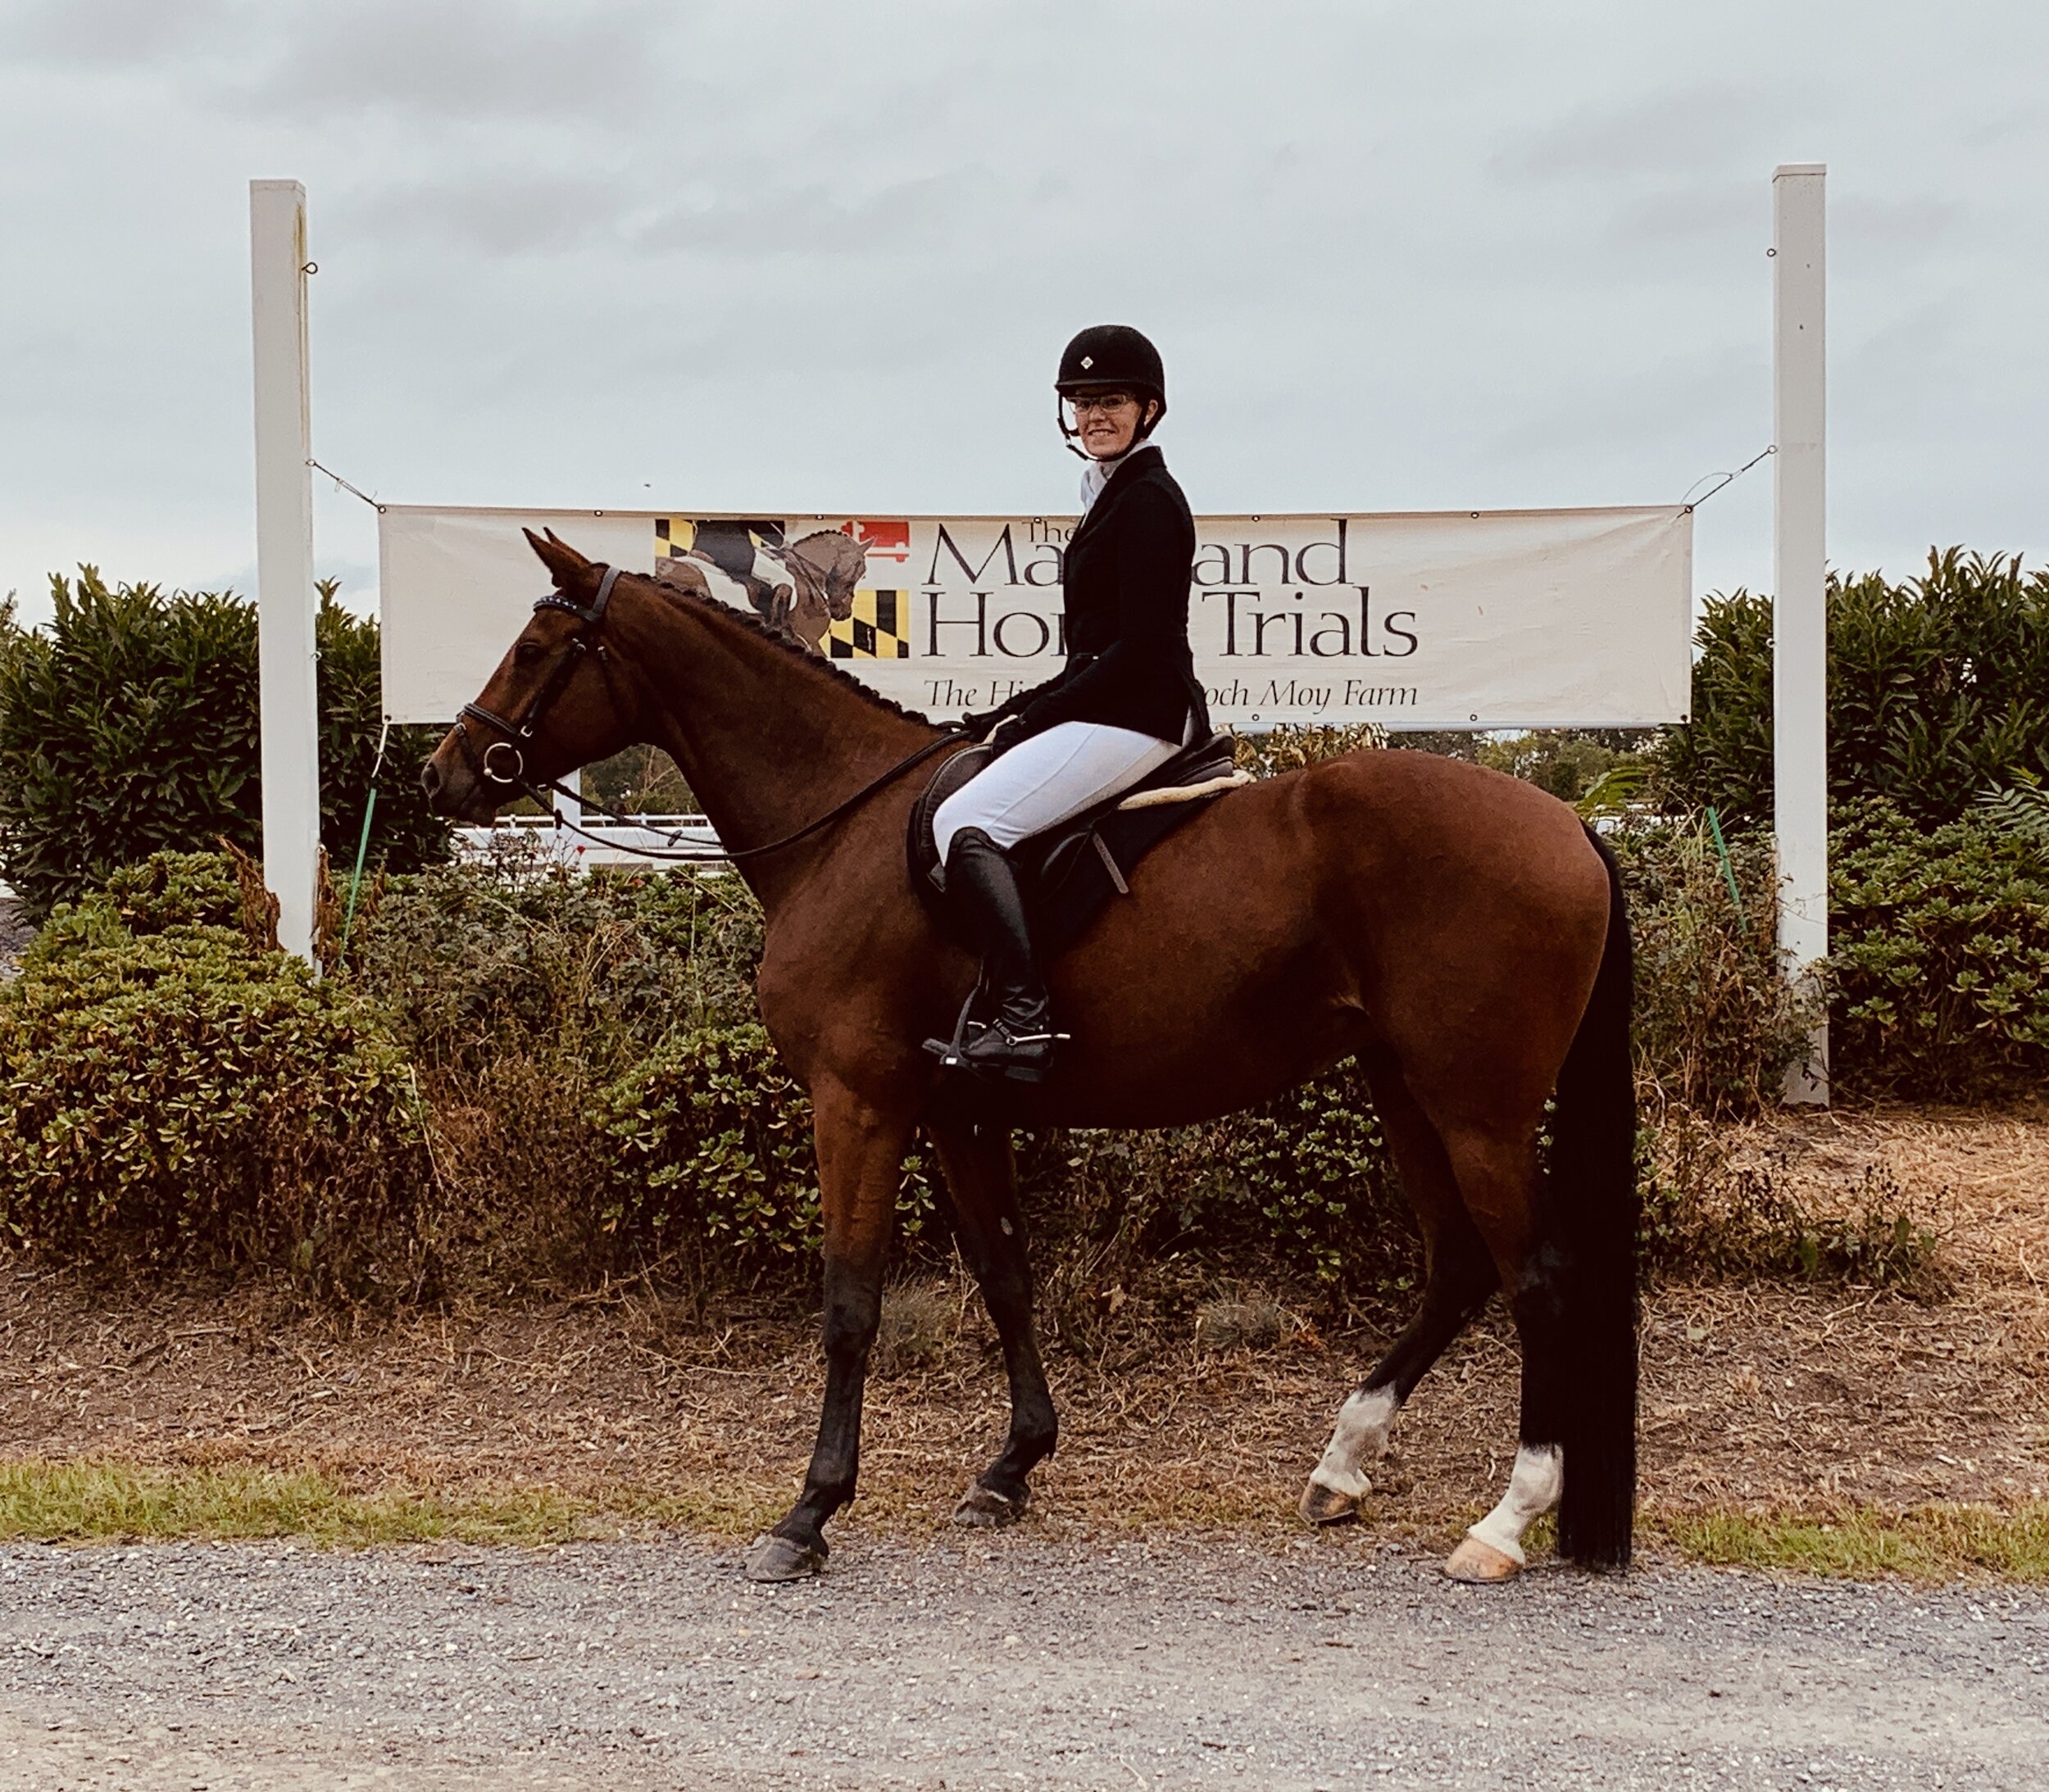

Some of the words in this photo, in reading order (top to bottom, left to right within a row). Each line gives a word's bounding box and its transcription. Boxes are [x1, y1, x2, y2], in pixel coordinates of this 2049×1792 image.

[921, 519, 1354, 587] Maand
[921, 592, 1068, 657] Hor
[1202, 586, 1418, 656] Trials
[925, 679, 977, 706] The
[1205, 679, 1248, 706] och
[1260, 679, 1331, 715] Moy
[1343, 679, 1417, 706] Farm
